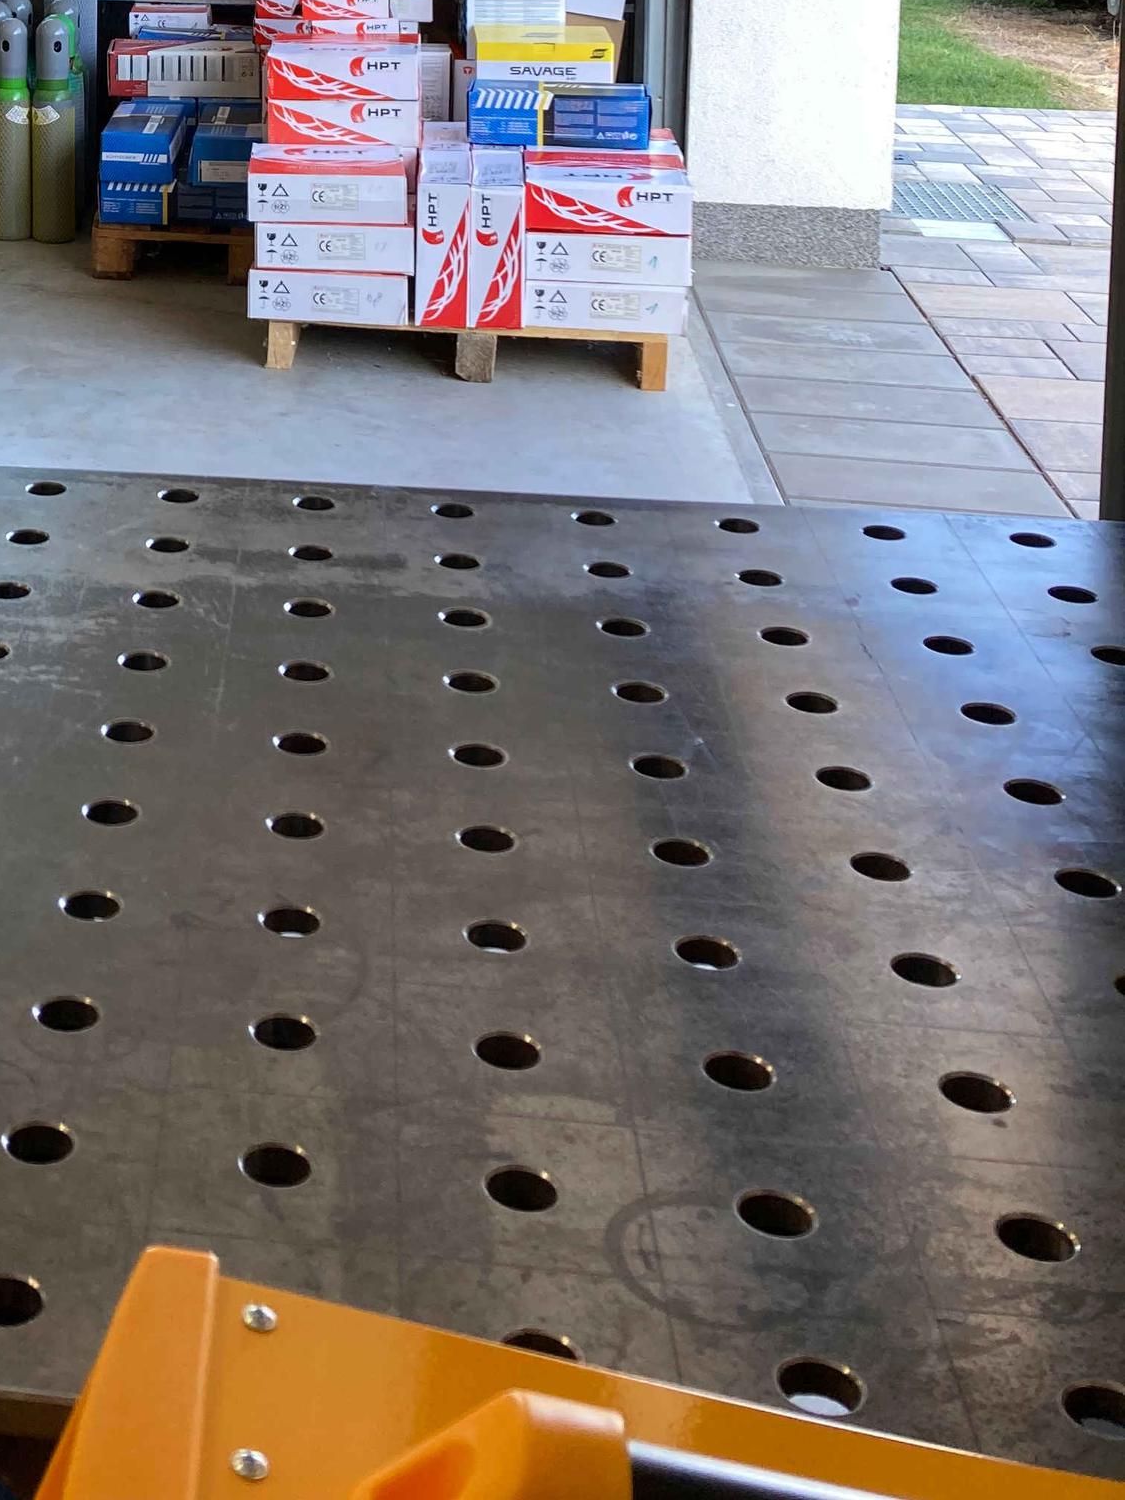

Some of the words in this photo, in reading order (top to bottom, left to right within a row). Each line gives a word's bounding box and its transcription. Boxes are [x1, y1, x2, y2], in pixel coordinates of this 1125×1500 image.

[367, 61, 401, 70] HPT
[510, 66, 577, 77] SAVAGE
[367, 108, 402, 117] HPT
[636, 192, 674, 202] HPT
[427, 193, 438, 227] HPT
[481, 194, 492, 228] HPT
